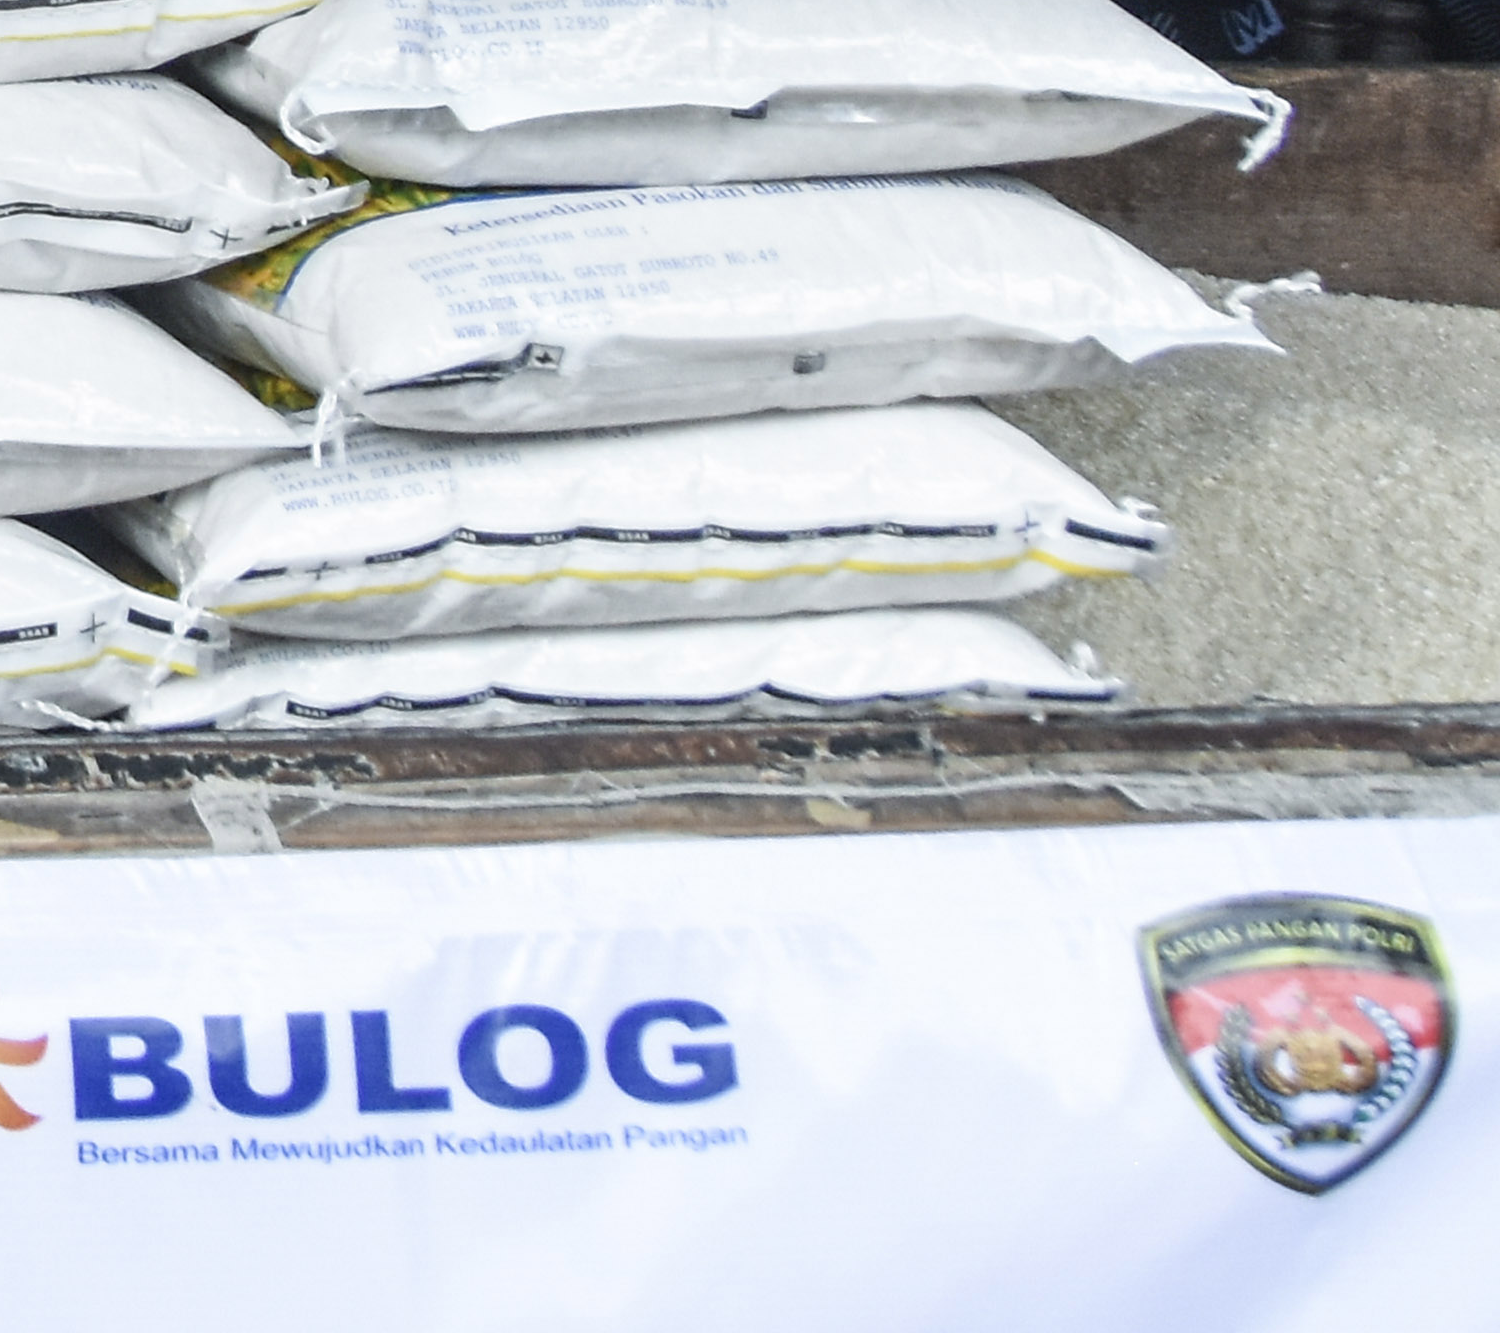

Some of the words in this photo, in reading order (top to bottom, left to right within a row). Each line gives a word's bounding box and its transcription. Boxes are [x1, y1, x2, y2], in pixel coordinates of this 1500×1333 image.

[443, 194, 627, 238] Ketersediaan
[633, 185, 749, 208] Pasokan
[369, 457, 454, 482] SELATAN
[1245, 919, 1342, 942] PANGAN
[67, 996, 742, 1124] BULOG
[75, 1137, 221, 1167] Bersama
[230, 1131, 426, 1168] Mewujudkan
[434, 1125, 613, 1159] Kedaulatan
[622, 1119, 750, 1155] Pangan
